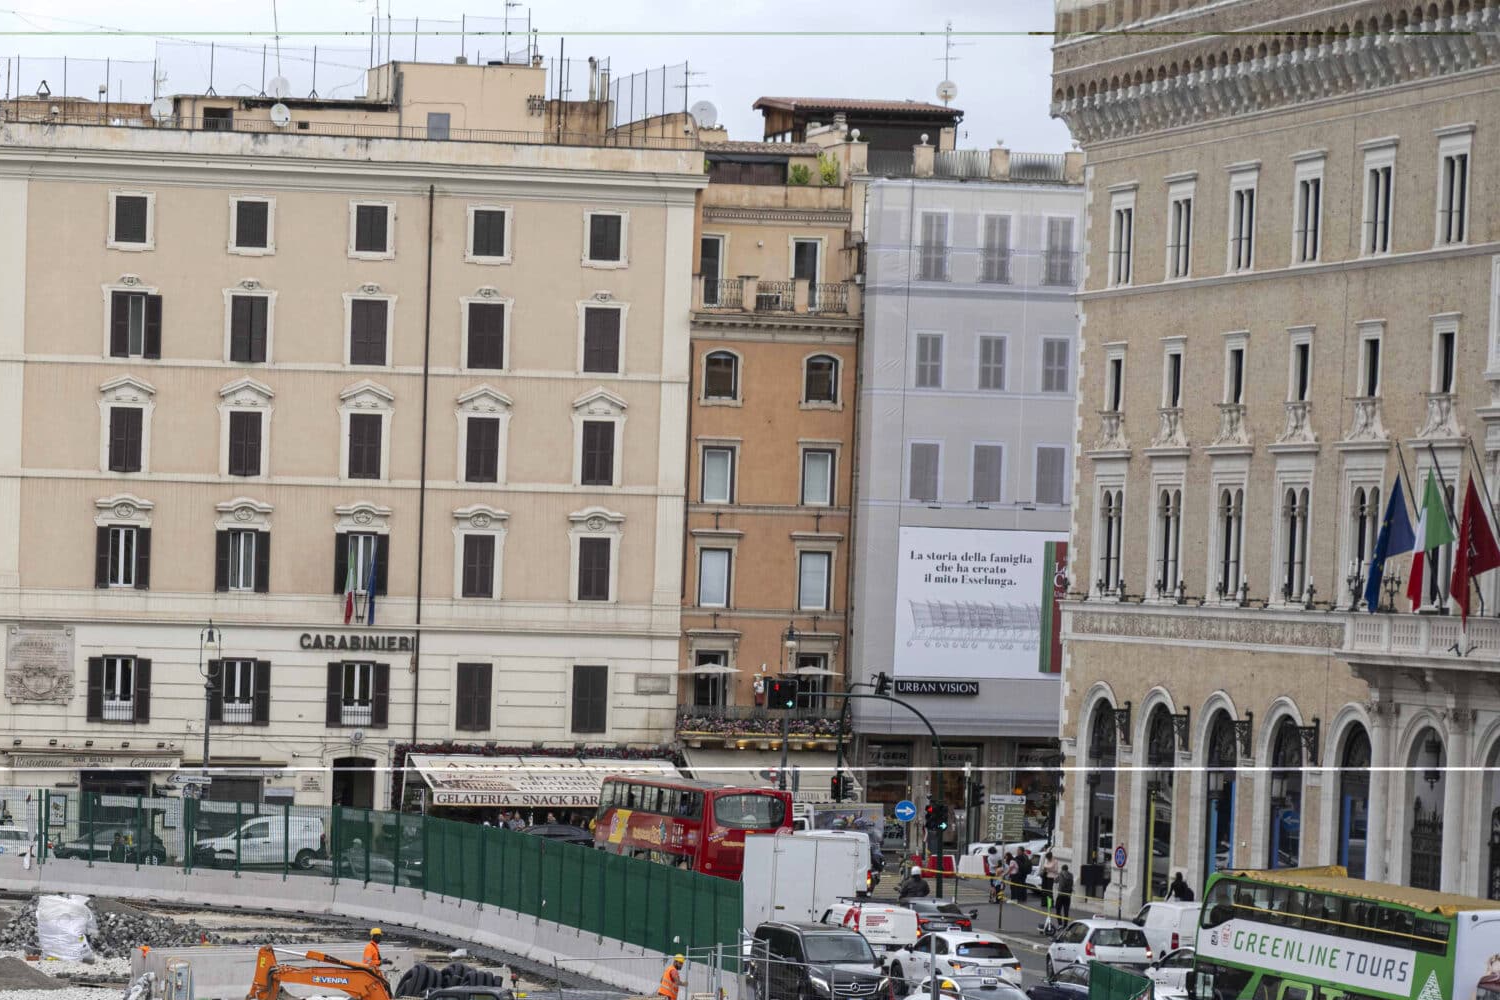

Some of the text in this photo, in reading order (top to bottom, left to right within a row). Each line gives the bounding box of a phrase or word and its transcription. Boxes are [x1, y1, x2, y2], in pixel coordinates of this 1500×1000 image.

[910, 551, 1033, 566] La storia della famiglia
[935, 564, 954, 573] che
[956, 564, 969, 573] ha
[924, 574, 1018, 589] il mito Esselunga.
[299, 633, 415, 652] CARABINIERI
[897, 682, 978, 694] URBAN VISION
[437, 794, 510, 804] GELATERIA
[522, 794, 568, 806] SNACK
[572, 795, 598, 806] BAR
[1234, 930, 1338, 969] GREENLINE
[1345, 951, 1409, 982] TOURS
[321, 976, 348, 984] VENPA
